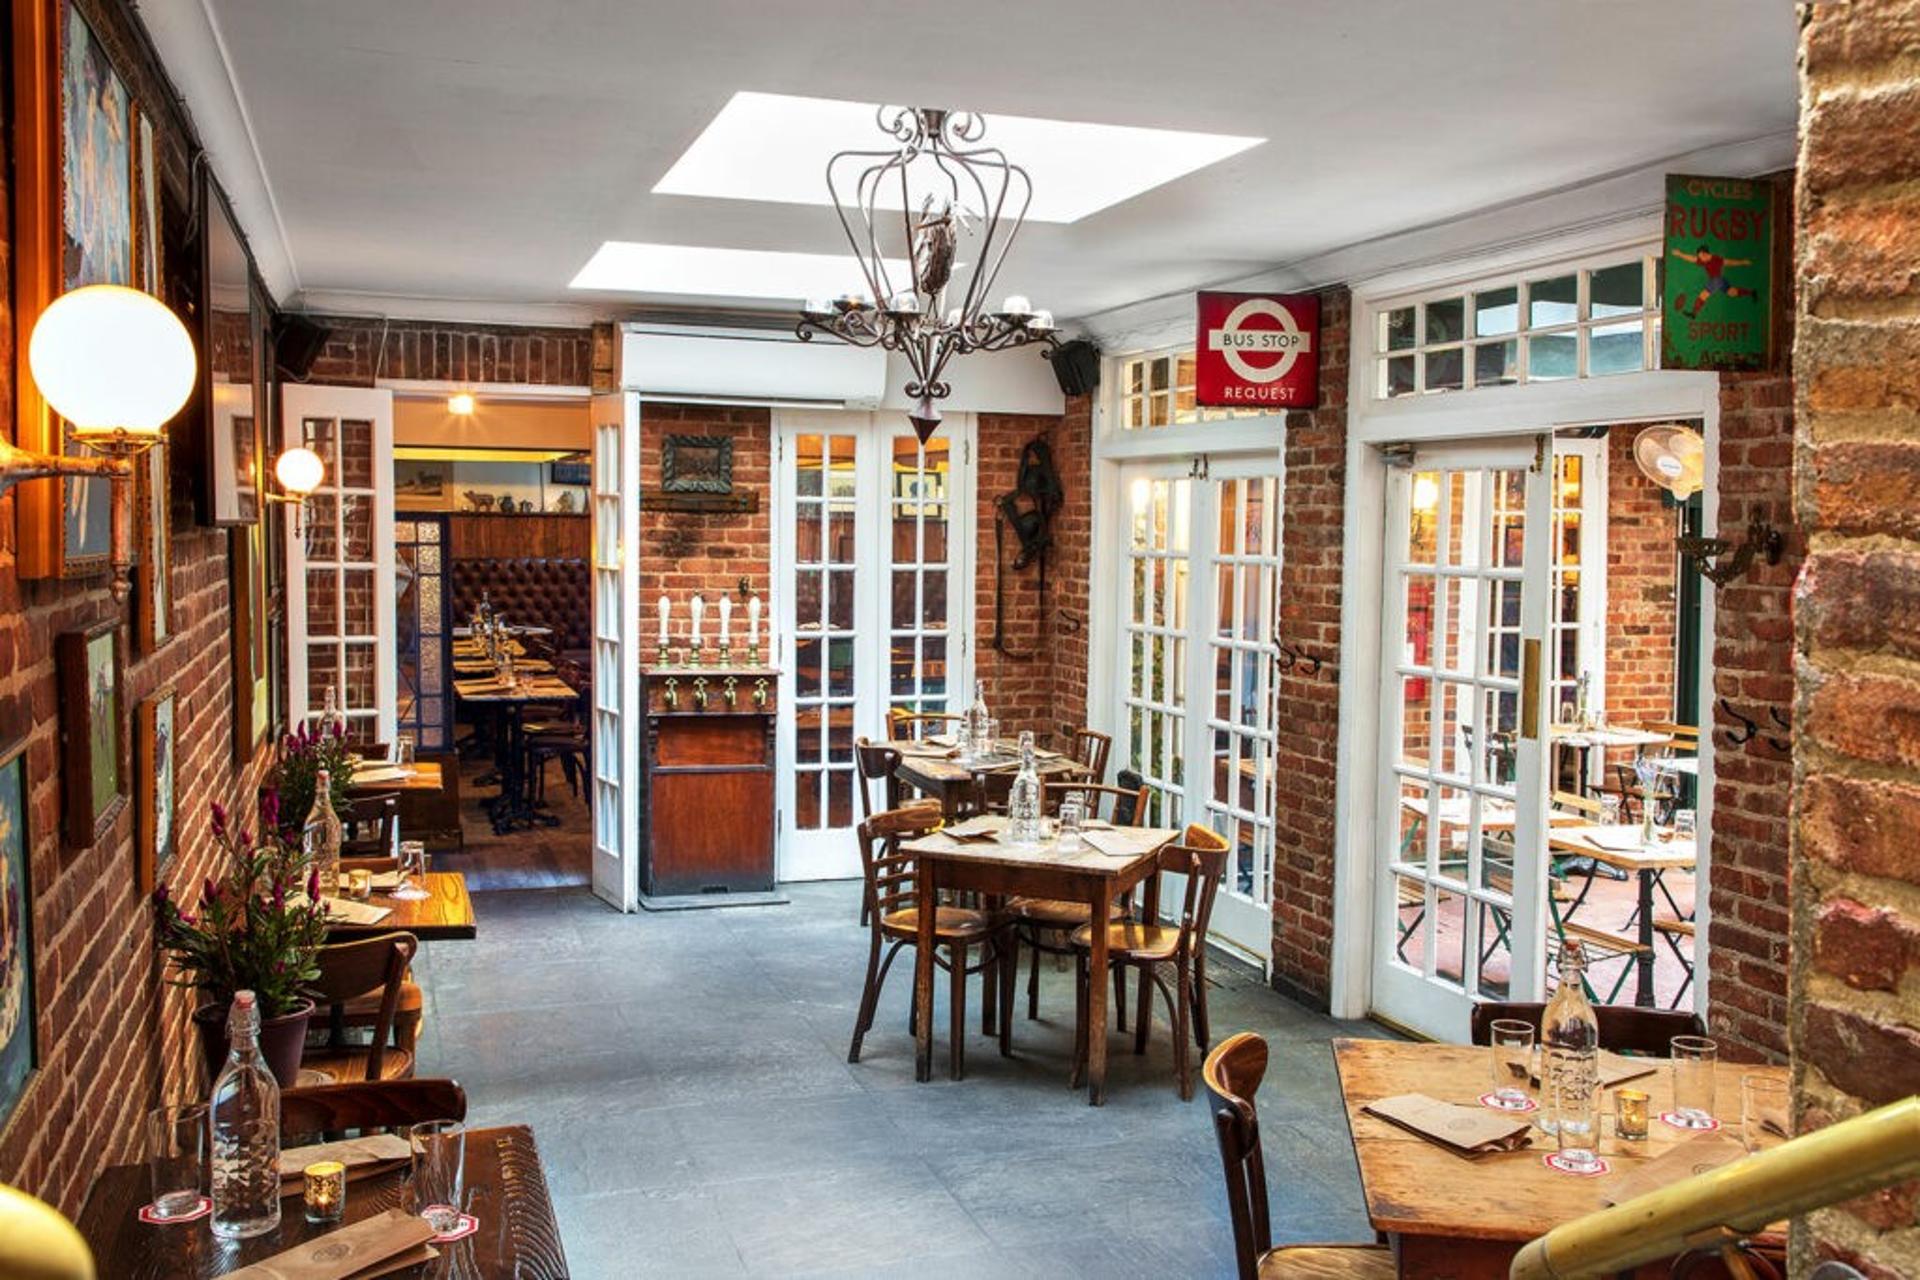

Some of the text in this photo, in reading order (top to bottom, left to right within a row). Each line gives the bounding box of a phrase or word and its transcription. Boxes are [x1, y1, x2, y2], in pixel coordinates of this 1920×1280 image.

[1687, 179, 1753, 199] CYCLES
[1670, 205, 1768, 240] RUGBY
[1223, 334, 1299, 348] BUS STOP
[1689, 322, 1750, 342] SPORT
[1224, 387, 1296, 400] REQUEST
